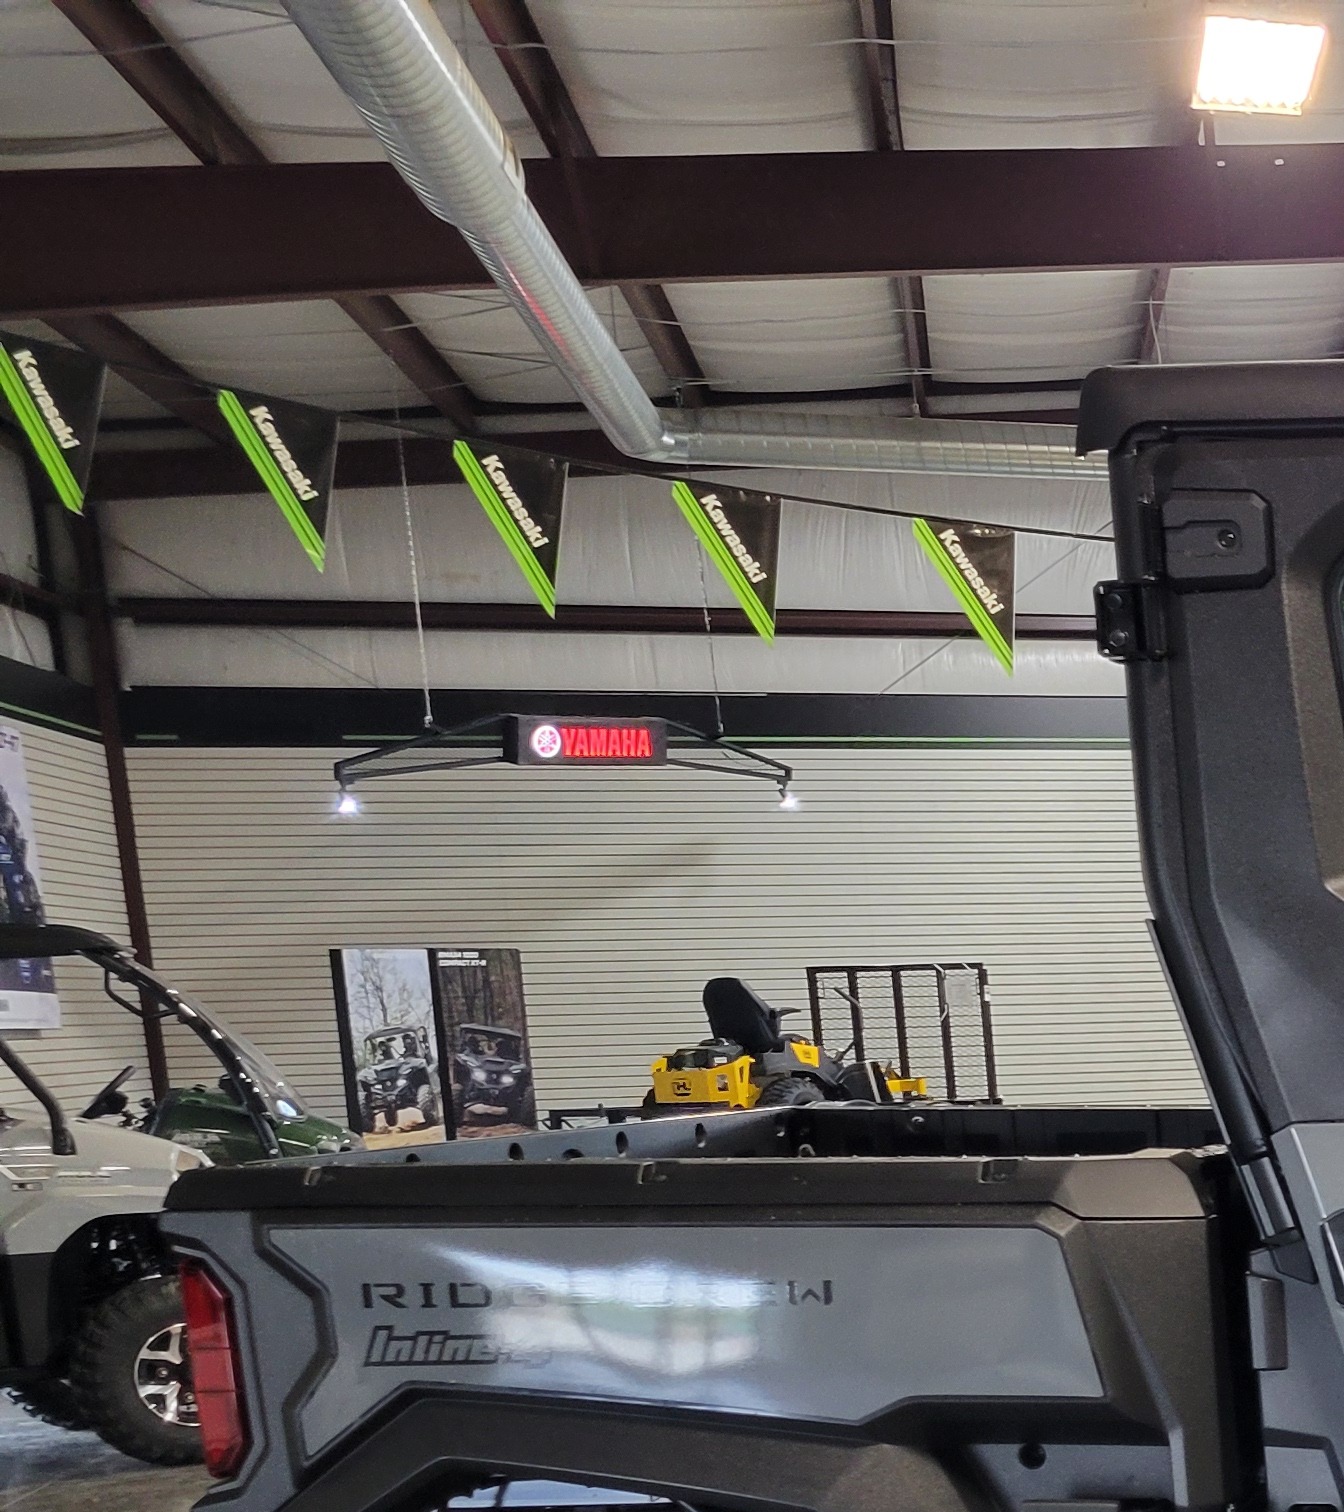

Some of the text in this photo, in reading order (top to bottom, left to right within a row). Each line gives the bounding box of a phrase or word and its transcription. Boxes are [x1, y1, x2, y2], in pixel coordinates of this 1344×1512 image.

[13, 350, 81, 450] Kawasaki
[249, 405, 320, 501] Kawasaki
[480, 454, 550, 549] Kawasaki
[700, 493, 767, 585] Kawasaki
[938, 528, 1005, 617] Kawasaki
[560, 726, 653, 758] YAMAHA
